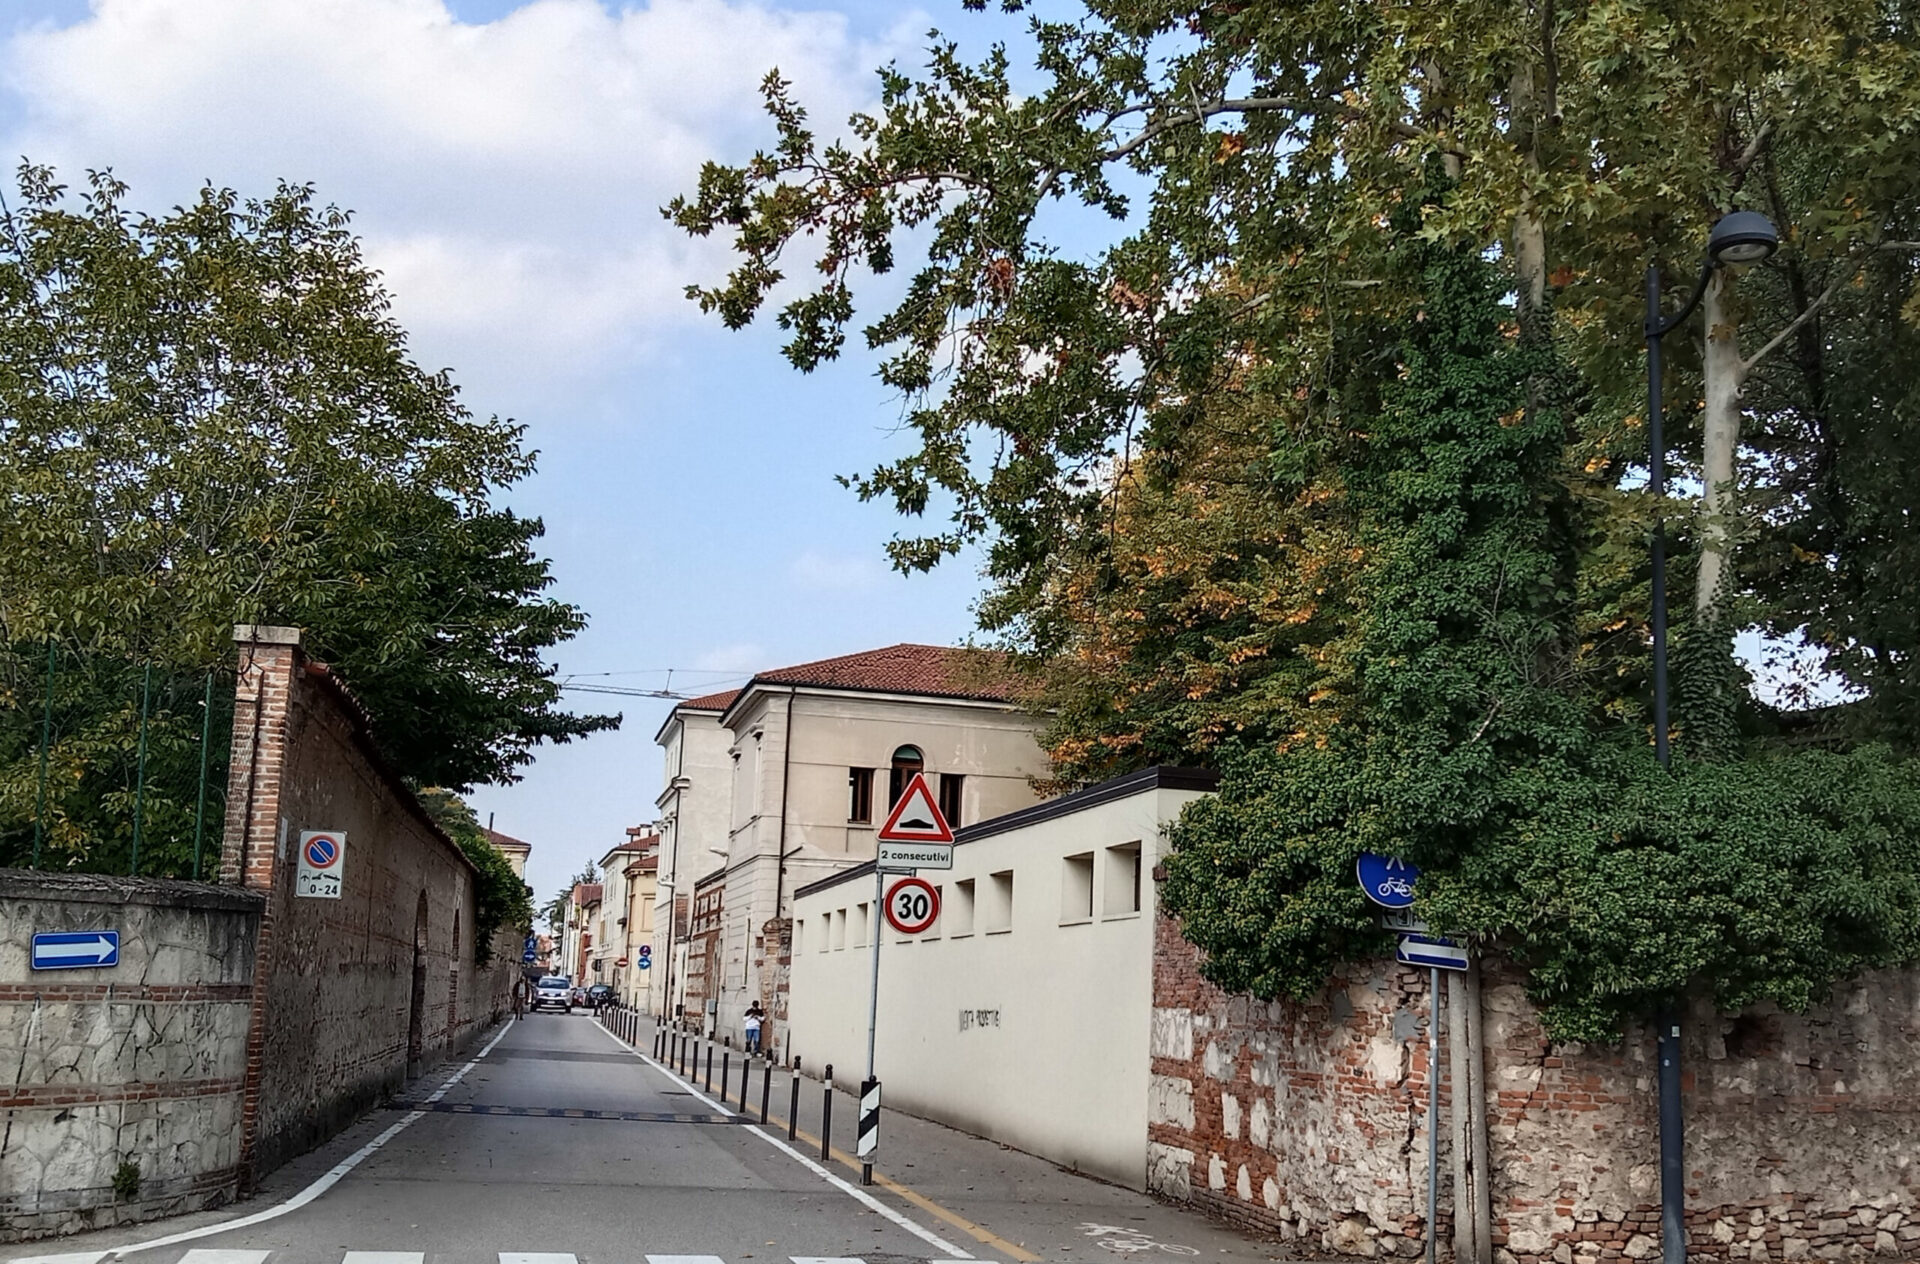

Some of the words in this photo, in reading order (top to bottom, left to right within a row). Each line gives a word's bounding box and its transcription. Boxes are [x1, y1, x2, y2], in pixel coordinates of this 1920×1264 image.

[881, 851, 889, 860] 2
[891, 852, 949, 862] consecutivi
[324, 885, 338, 895] 24
[898, 893, 929, 920] 30
